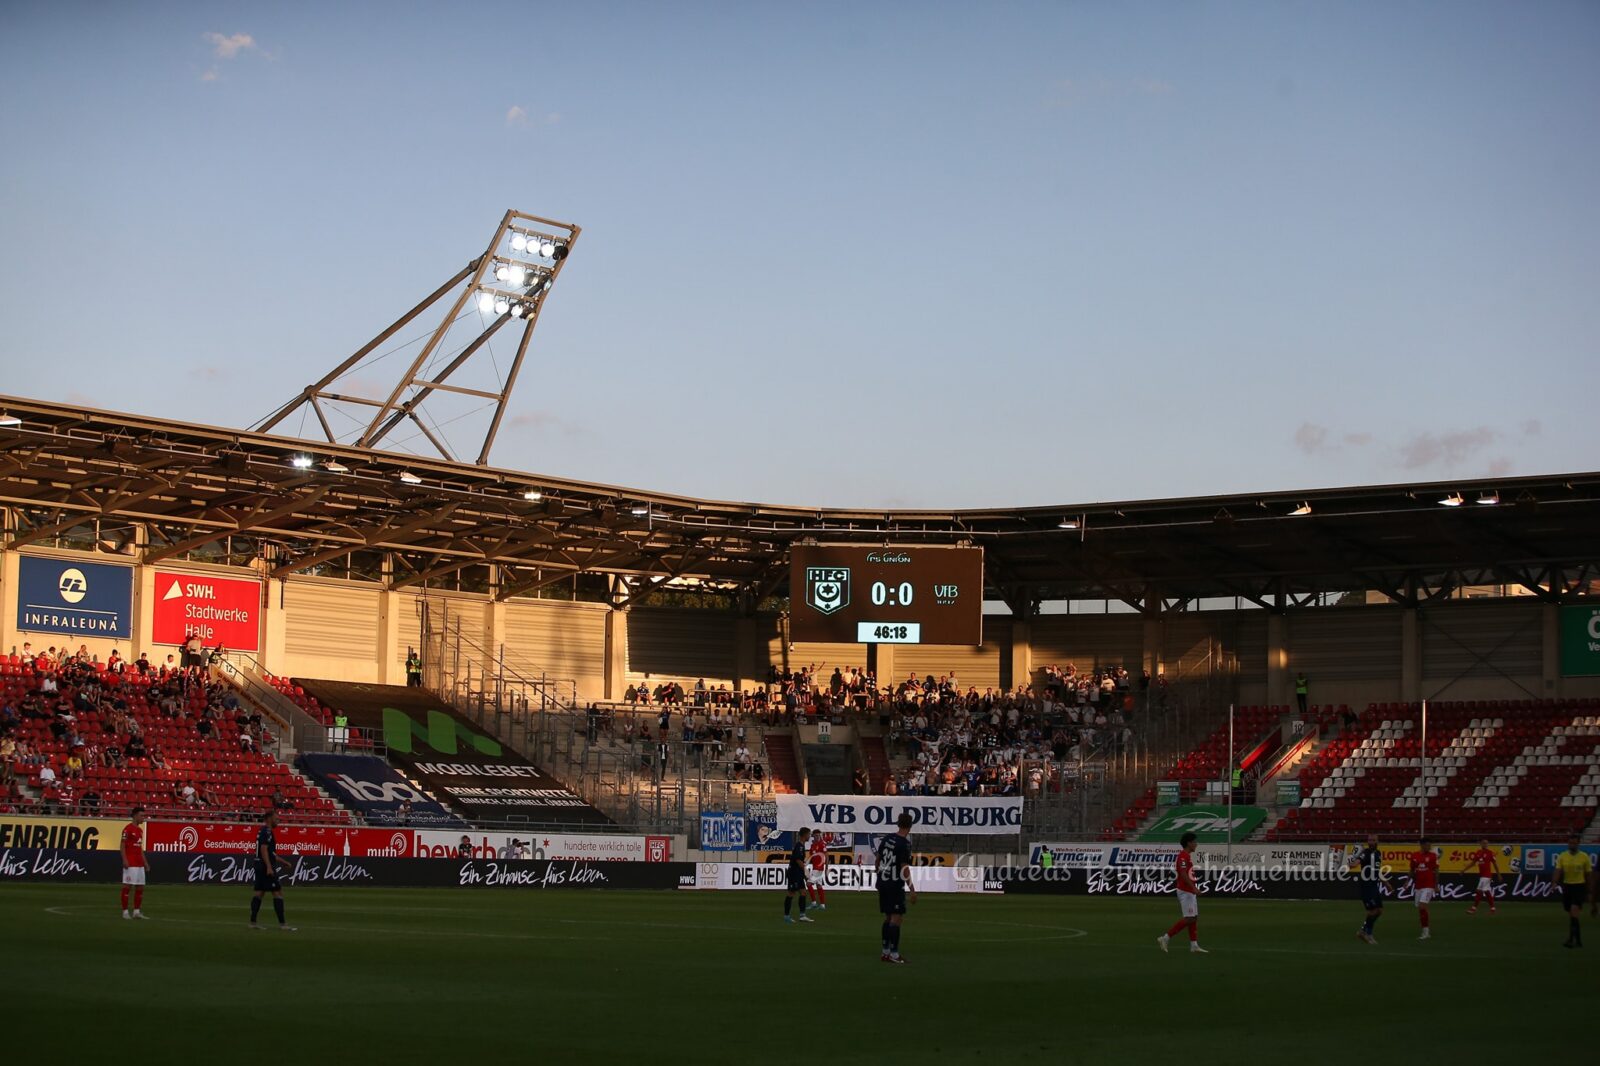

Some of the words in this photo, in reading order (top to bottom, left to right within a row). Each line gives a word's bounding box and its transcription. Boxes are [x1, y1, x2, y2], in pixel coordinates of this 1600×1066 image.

[186, 584, 216, 599] SWH.
[871, 581, 914, 606] 0:0
[185, 604, 248, 622] Stadtwerke
[185, 624, 214, 639] Halle
[874, 626, 907, 639] 46:18
[414, 762, 541, 778] MOBILEBET
[444, 786, 488, 796] DEINE
[808, 804, 856, 824] VfB
[864, 805, 1022, 826] OLDENBURG
[702, 819, 743, 843] FLAMES
[153, 840, 188, 853] muth
[275, 842, 295, 851] nsere
[367, 846, 398, 857] muth
[564, 840, 597, 851] hunderte
[599, 842, 625, 851] wirklich
[626, 843, 642, 851] tolle
[32, 849, 88, 876] Leben.
[1030, 847, 1104, 866] Lhrmann
[1272, 851, 1322, 859] ZUSAMMEN
[187, 855, 218, 882] Ein
[291, 855, 319, 885] fürs
[324, 855, 373, 881] Leben.
[459, 861, 484, 886] Ein
[483, 862, 541, 886] Zuhause
[541, 861, 566, 888] fürs
[569, 860, 609, 884] Leben.
[701, 863, 719, 875] 100
[732, 867, 753, 886] DIE
[679, 875, 695, 885] HWG
[984, 880, 1003, 890] HWG
[1087, 870, 1114, 894] Ein
[1116, 872, 1178, 895] Zuhause
[1215, 870, 1266, 893] Leben.
